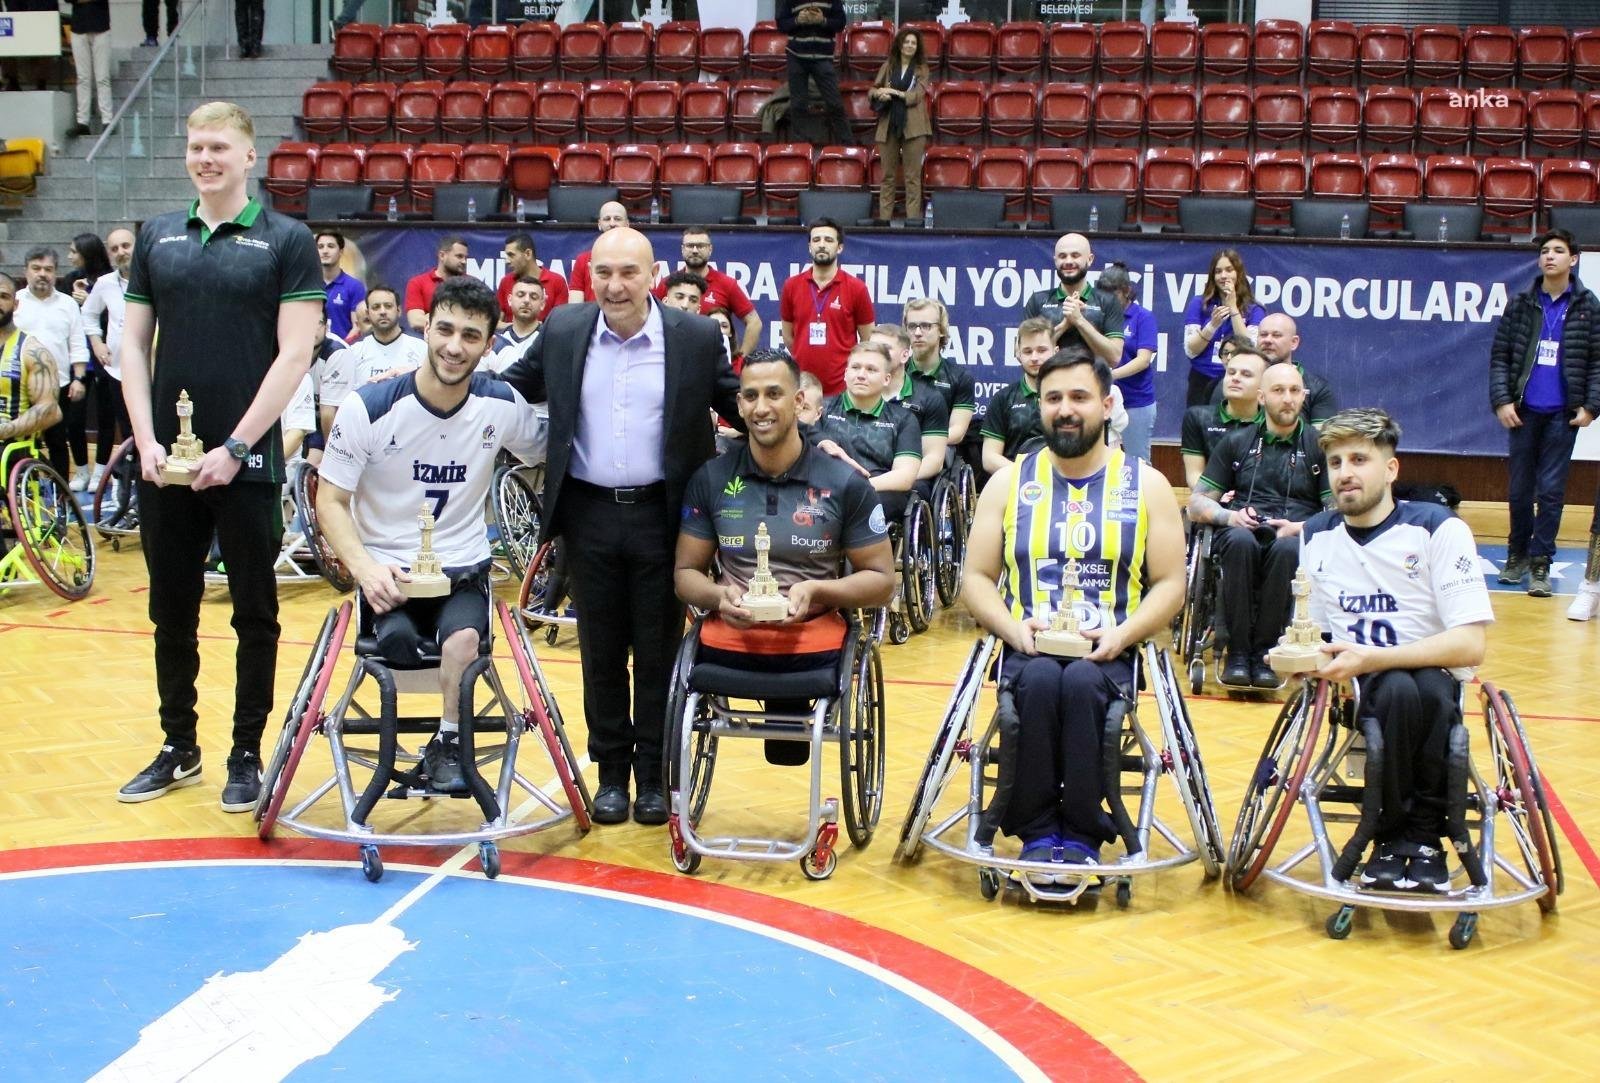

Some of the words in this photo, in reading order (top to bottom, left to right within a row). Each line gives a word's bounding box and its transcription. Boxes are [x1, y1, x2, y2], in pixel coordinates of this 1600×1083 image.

[524, 5, 558, 15] BELEDİY
[1041, 3, 1093, 15] BELEDİYESİ
[1247, 274, 1508, 323] PORCULARA
[412, 459, 467, 484] İZMİR
[425, 489, 450, 522] 7
[1055, 521, 1097, 552] 10
[1337, 588, 1399, 614] İZMİR
[1346, 618, 1400, 648] 10
